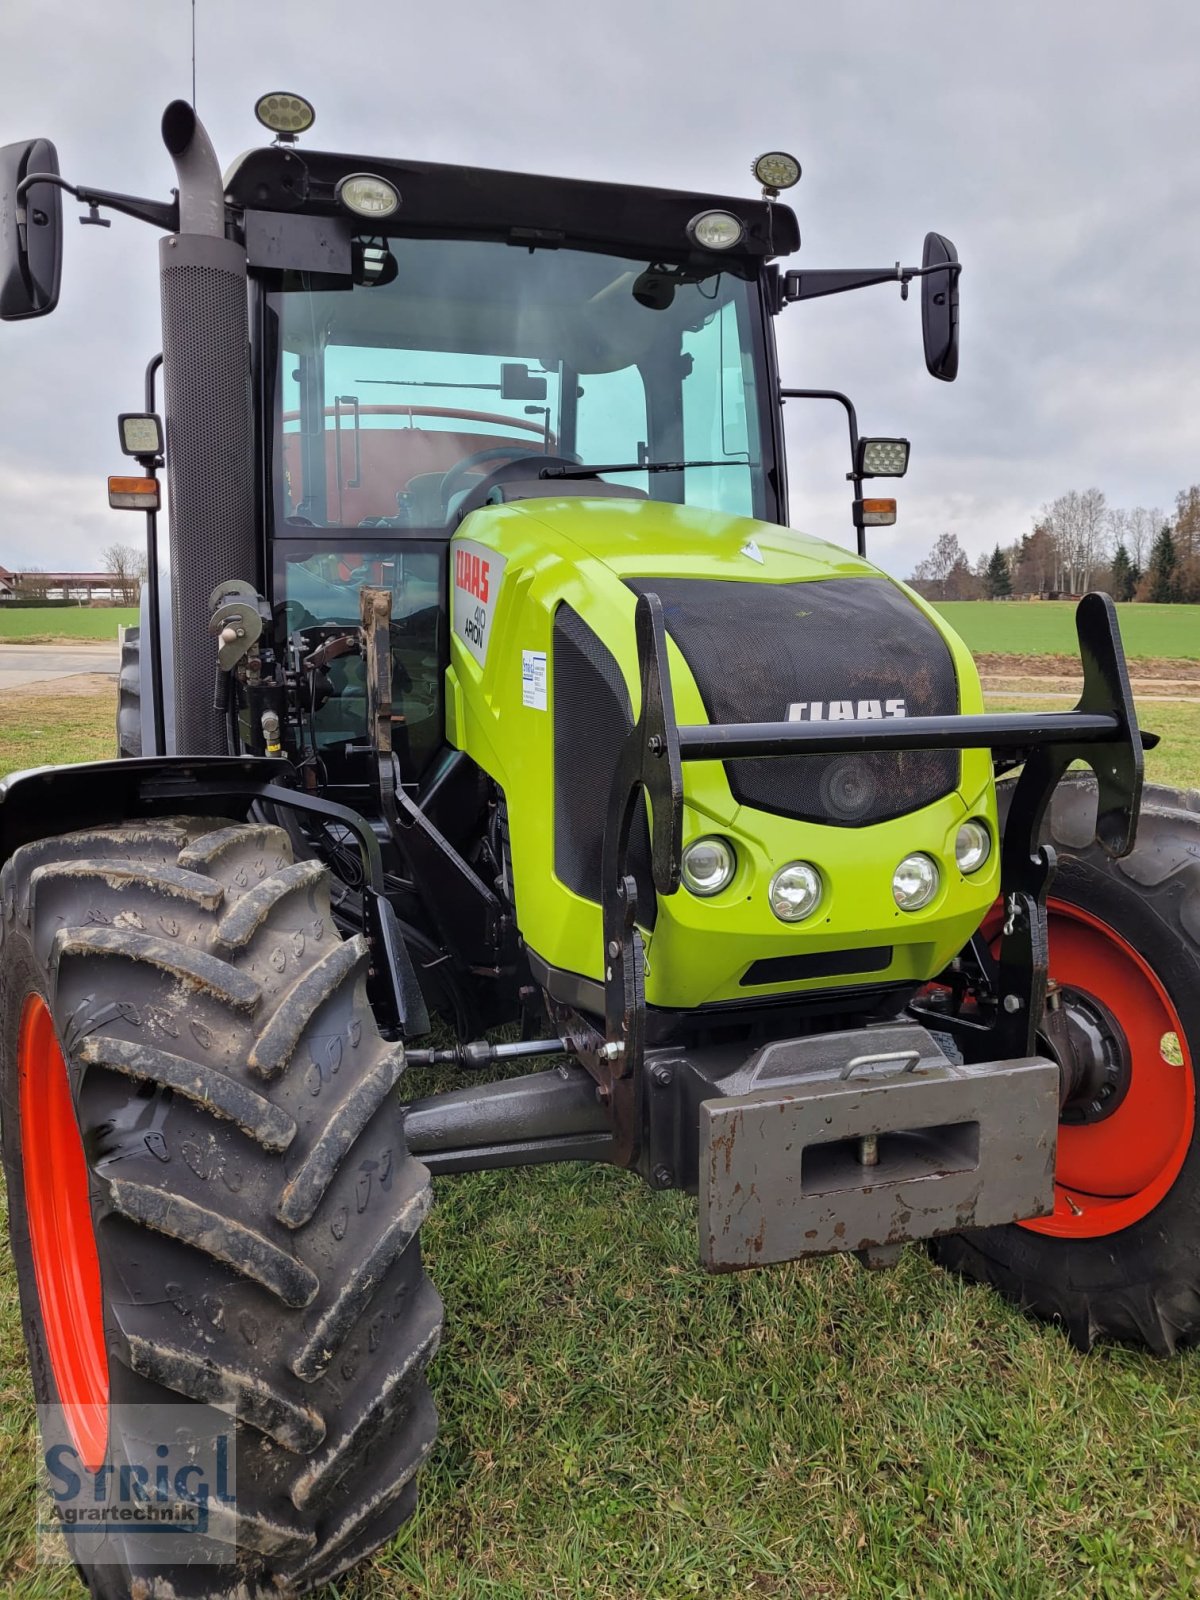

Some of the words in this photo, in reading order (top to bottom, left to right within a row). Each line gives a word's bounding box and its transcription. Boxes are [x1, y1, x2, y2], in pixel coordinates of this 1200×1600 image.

[456, 549, 490, 604] CLAAS
[464, 617, 484, 649] ARION
[788, 699, 906, 722] CLAAS
